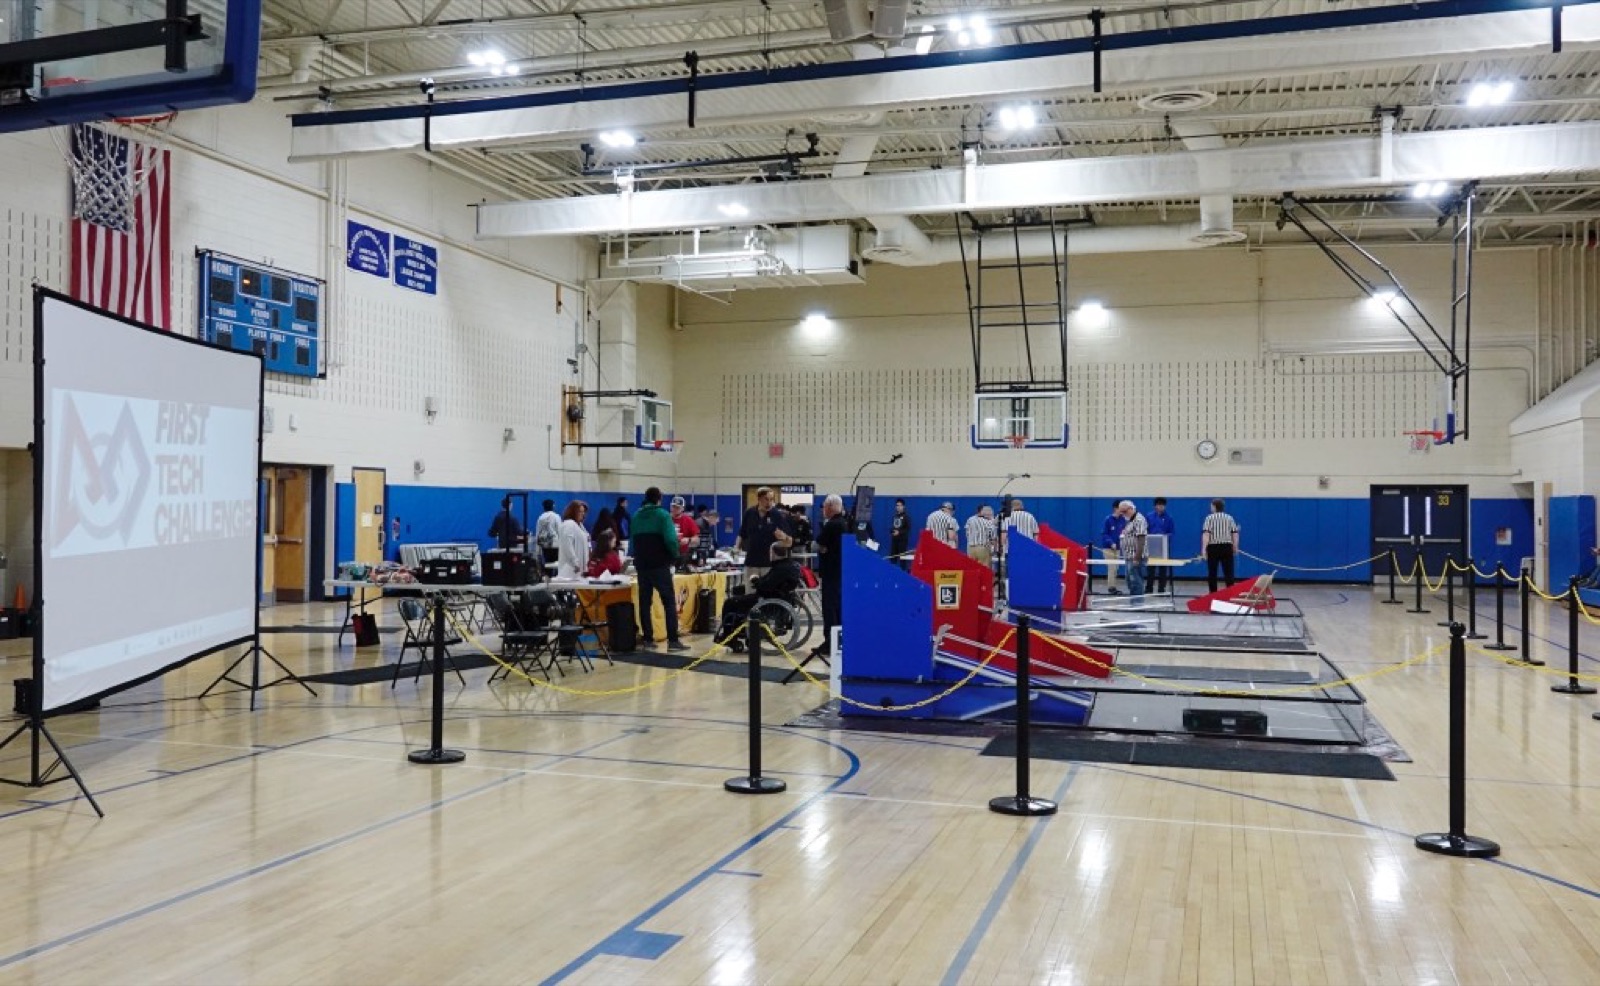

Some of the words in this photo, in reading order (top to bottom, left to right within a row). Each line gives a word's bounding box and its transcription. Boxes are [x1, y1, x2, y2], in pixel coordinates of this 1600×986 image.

[211, 261, 234, 276] HOME
[293, 281, 318, 296] VISITOR
[251, 308, 270, 319] PERIOD
[215, 321, 234, 333] FOULS
[248, 328, 267, 339] PLAYER
[269, 332, 286, 343] FOULS
[155, 400, 211, 446] FIRST
[155, 454, 204, 496] TECH
[1438, 494, 1450, 506] 33
[155, 499, 252, 546] CHALLENGE
